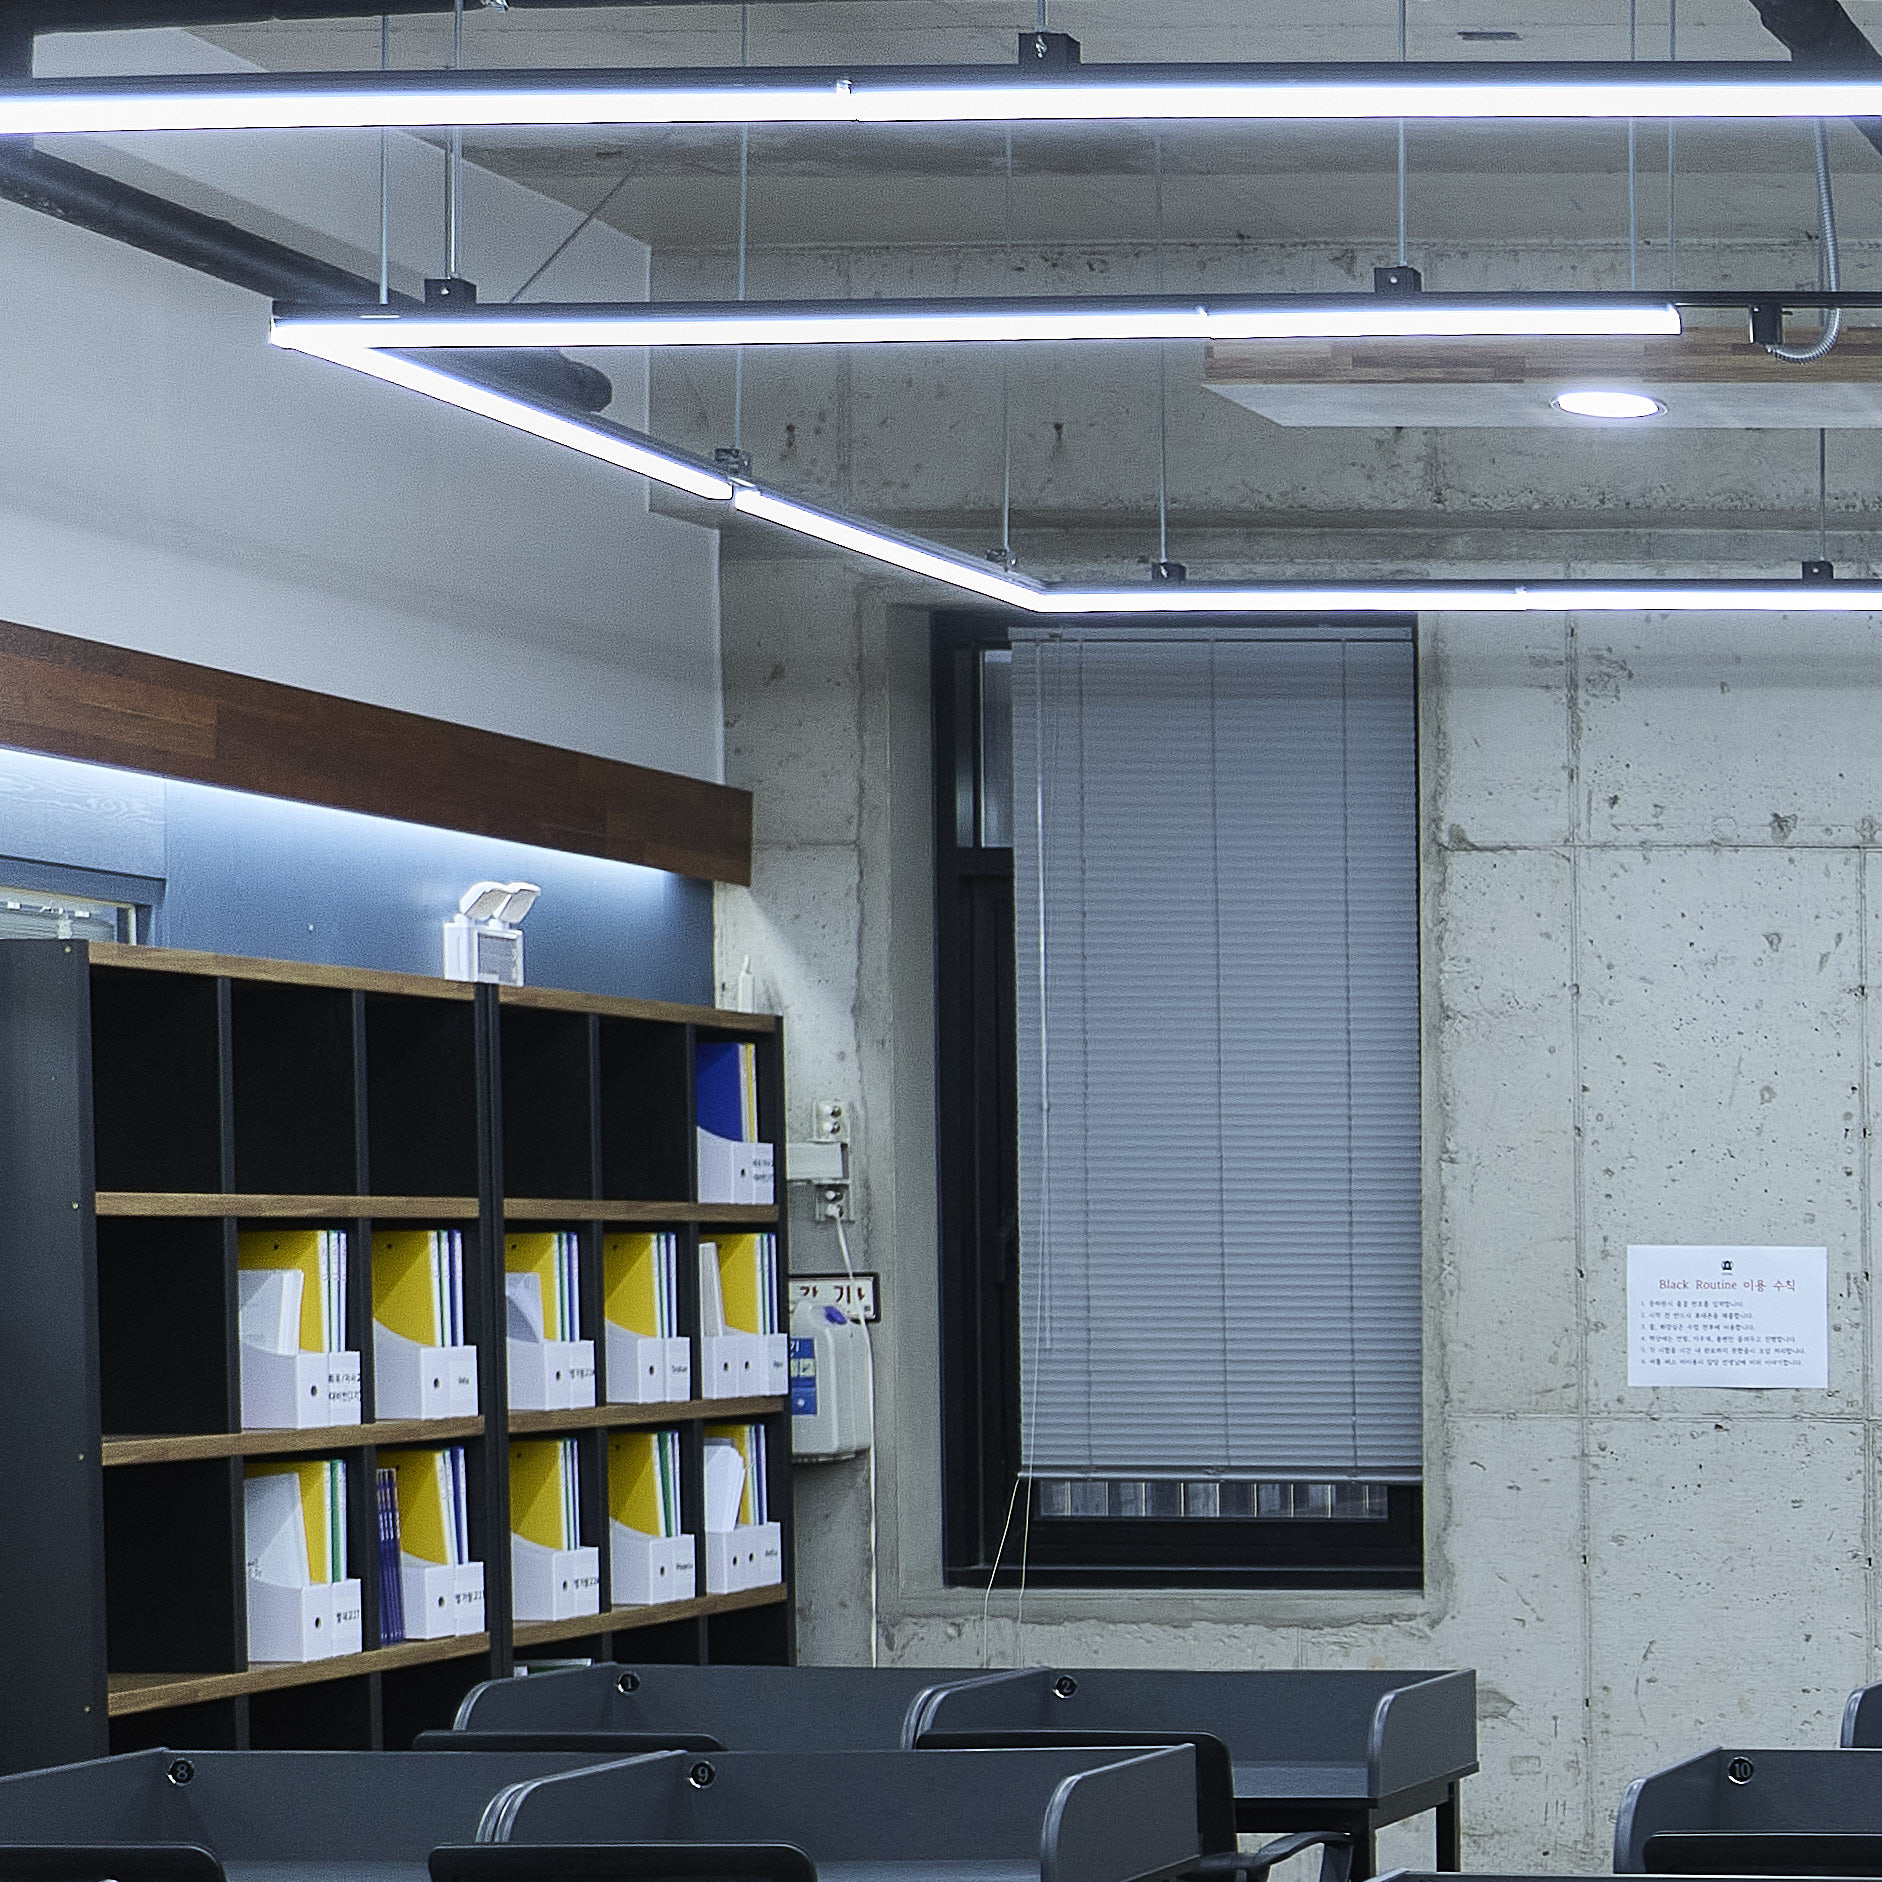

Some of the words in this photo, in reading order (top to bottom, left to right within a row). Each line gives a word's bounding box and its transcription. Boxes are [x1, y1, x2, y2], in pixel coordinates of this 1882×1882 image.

[1658, 1279, 1690, 1291] Black
[1695, 1279, 1738, 1291] Routine
[1743, 1278, 1767, 1293] 이용
[626, 1678, 633, 1688] 1
[1061, 1679, 1071, 1693] 2
[177, 1764, 187, 1779] 8
[697, 1767, 707, 1782] 9
[1733, 1764, 1750, 1777] 10
